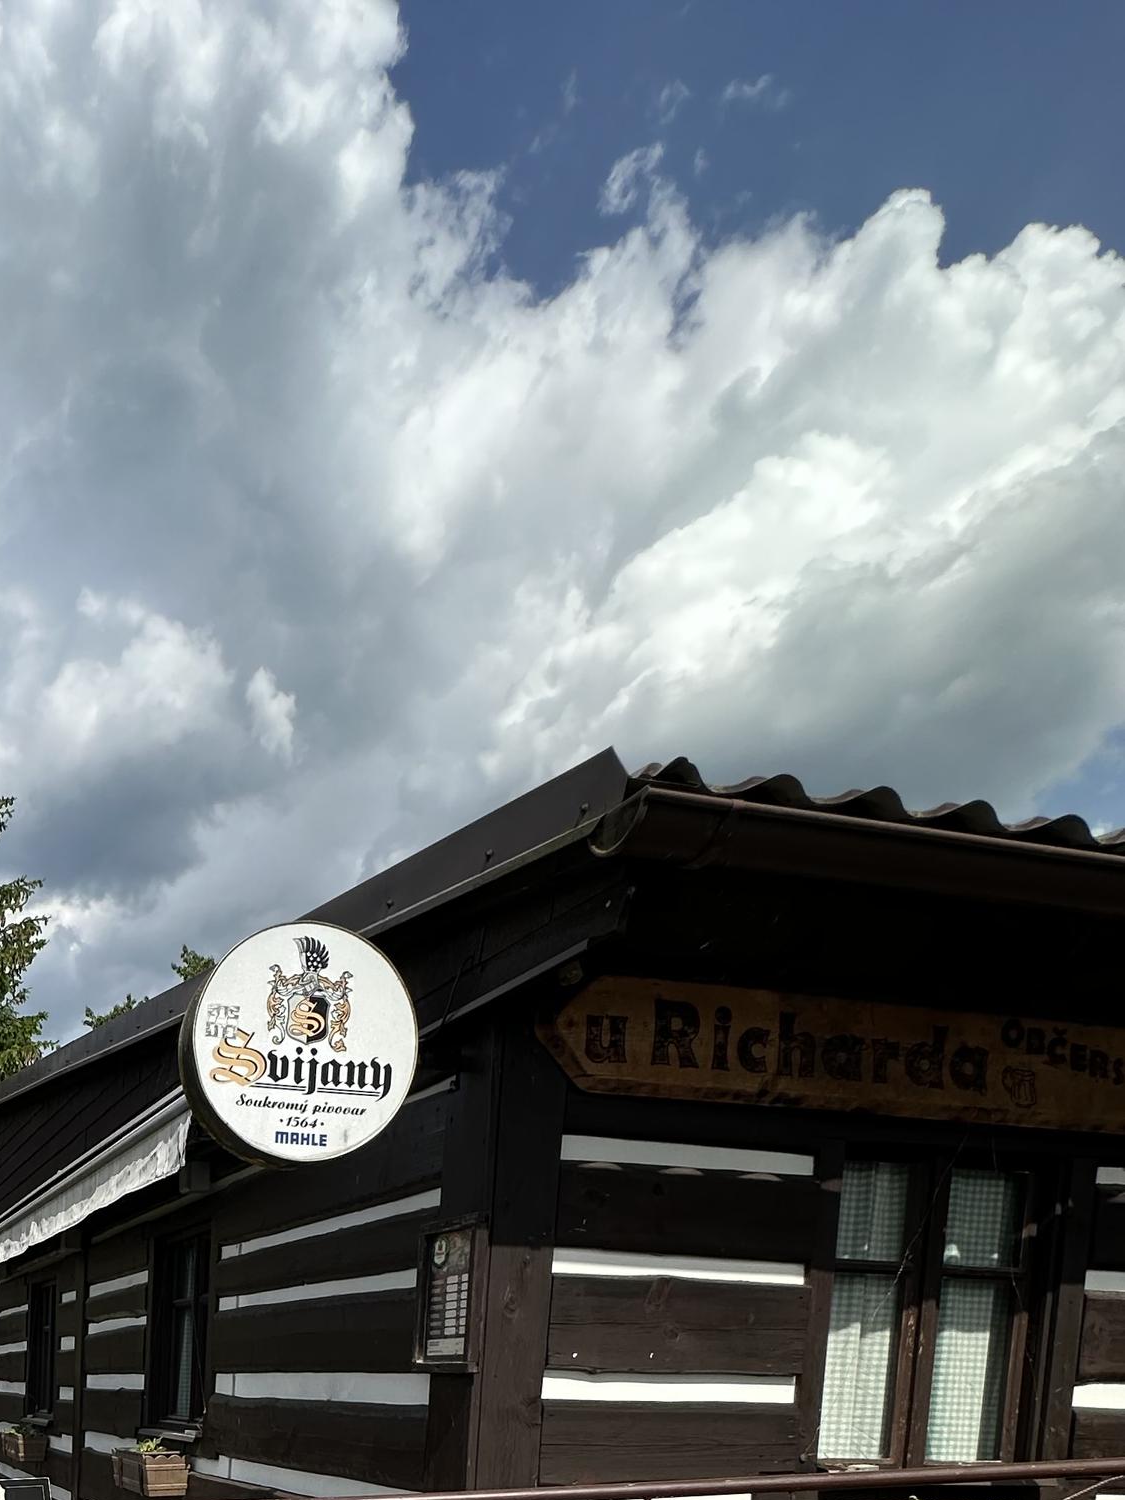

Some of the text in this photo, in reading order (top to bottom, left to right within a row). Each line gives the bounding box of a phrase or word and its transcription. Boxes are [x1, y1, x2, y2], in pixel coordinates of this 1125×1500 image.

[209, 1029, 393, 1102] Svijany
[585, 999, 990, 1096] u Richarda
[235, 1093, 367, 1116] Soukromý pivovar
[275, 1131, 328, 1147] MAHLE
